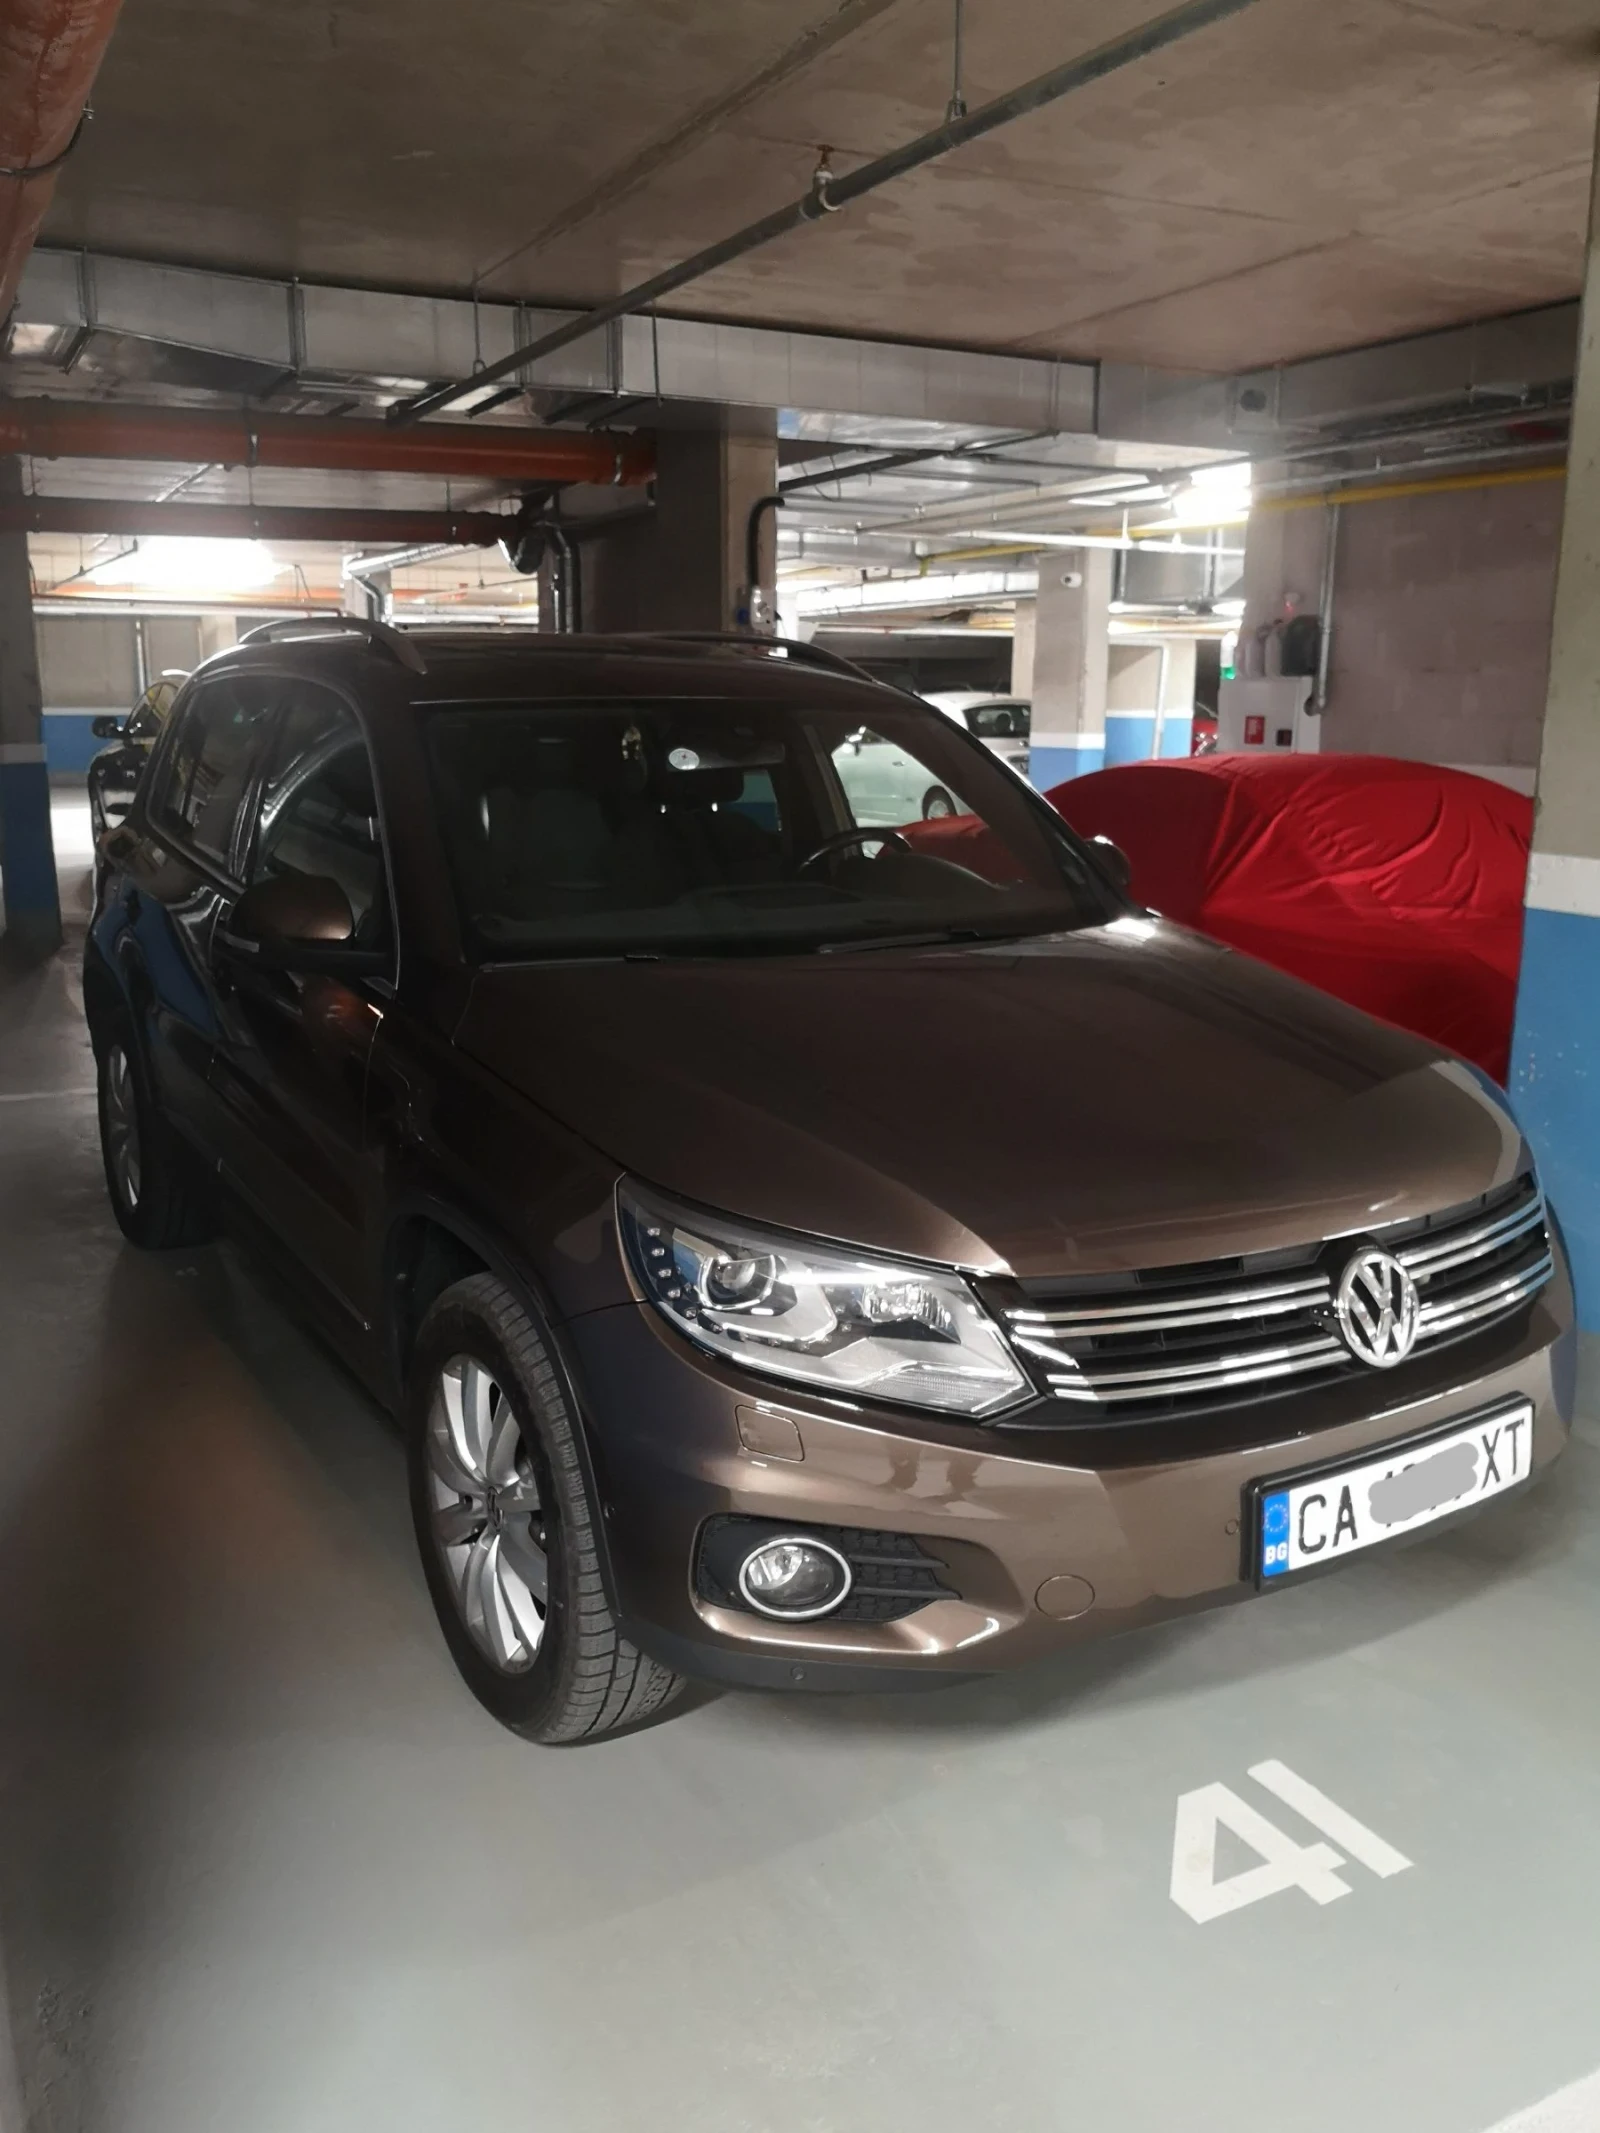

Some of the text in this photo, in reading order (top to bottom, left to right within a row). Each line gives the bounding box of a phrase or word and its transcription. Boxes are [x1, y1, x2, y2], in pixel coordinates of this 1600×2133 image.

[1265, 1542, 1288, 1566] BG
[1299, 1484, 1358, 1554] CA
[1481, 1418, 1525, 1490] XT
[1169, 1758, 1415, 1925] 41
